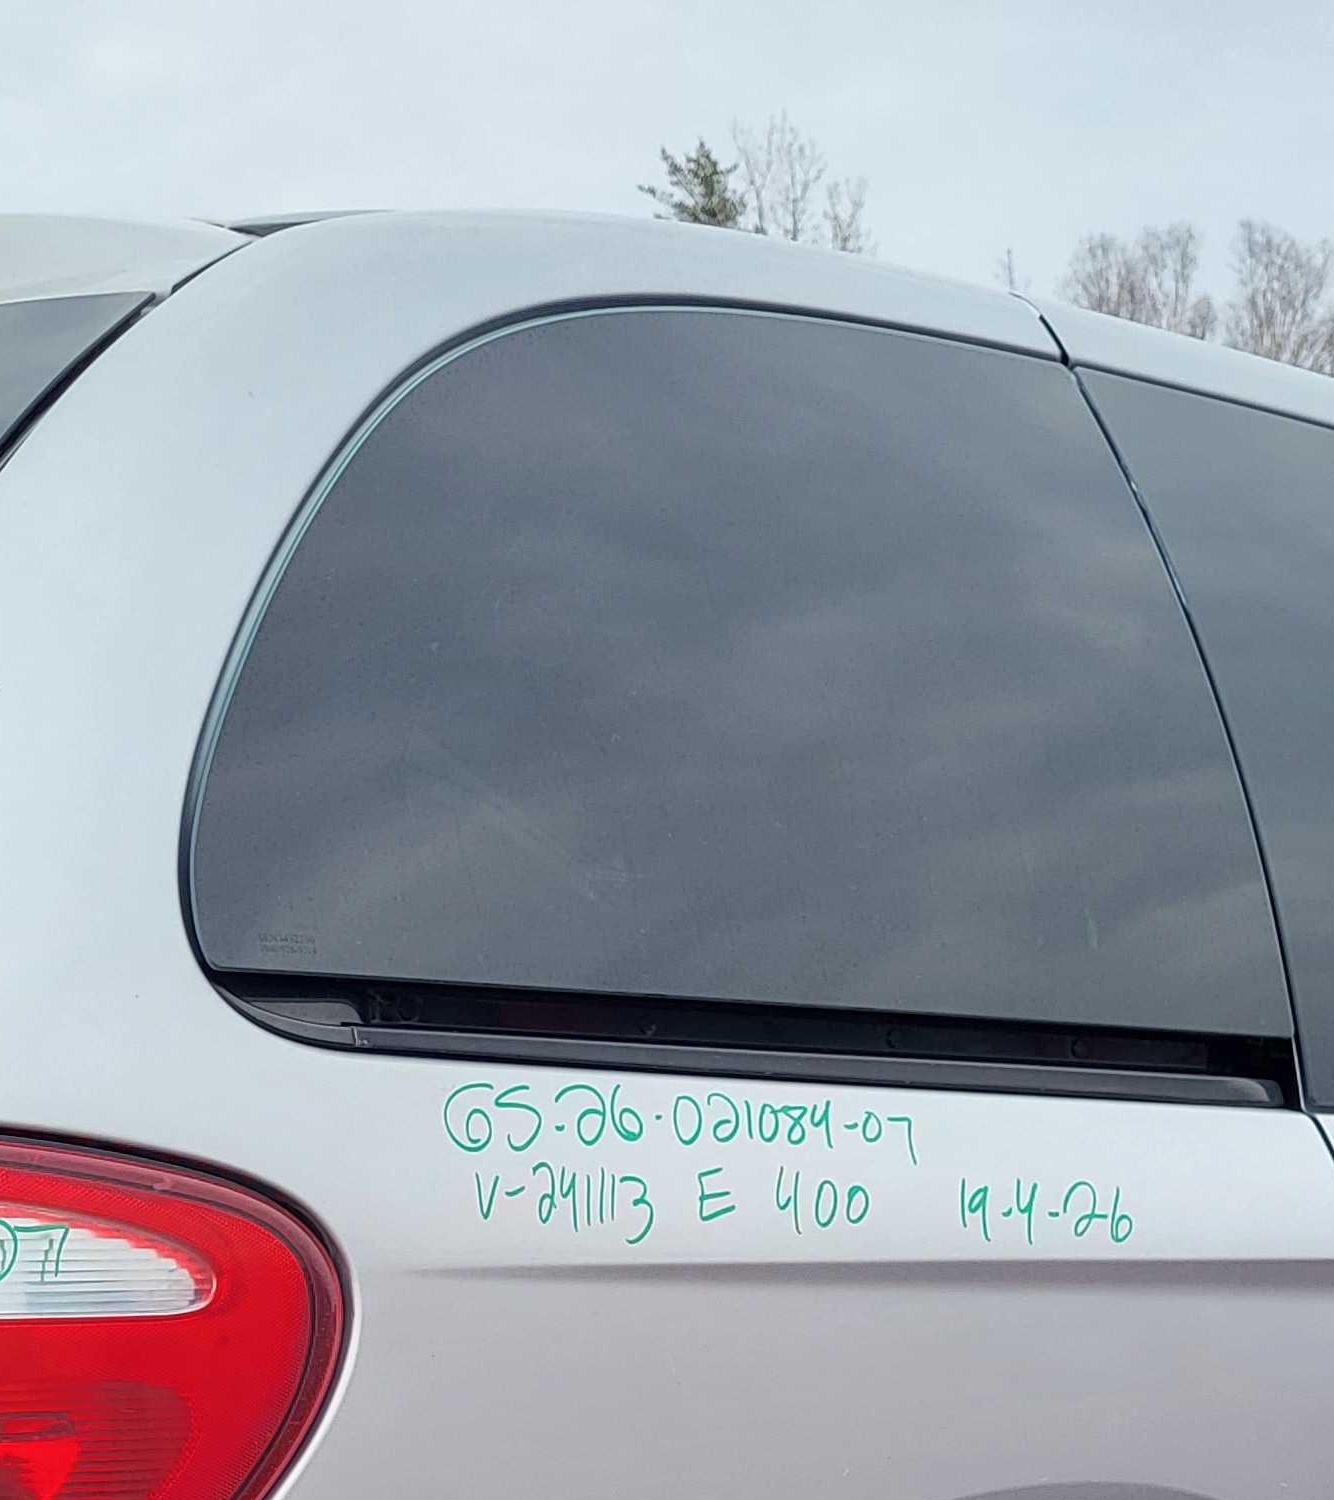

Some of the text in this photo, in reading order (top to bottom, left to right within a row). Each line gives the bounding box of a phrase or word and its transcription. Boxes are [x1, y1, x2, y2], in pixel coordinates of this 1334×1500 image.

[475, 1161, 655, 1245] V-241113
[698, 1167, 736, 1222] E
[775, 1165, 870, 1235] 400
